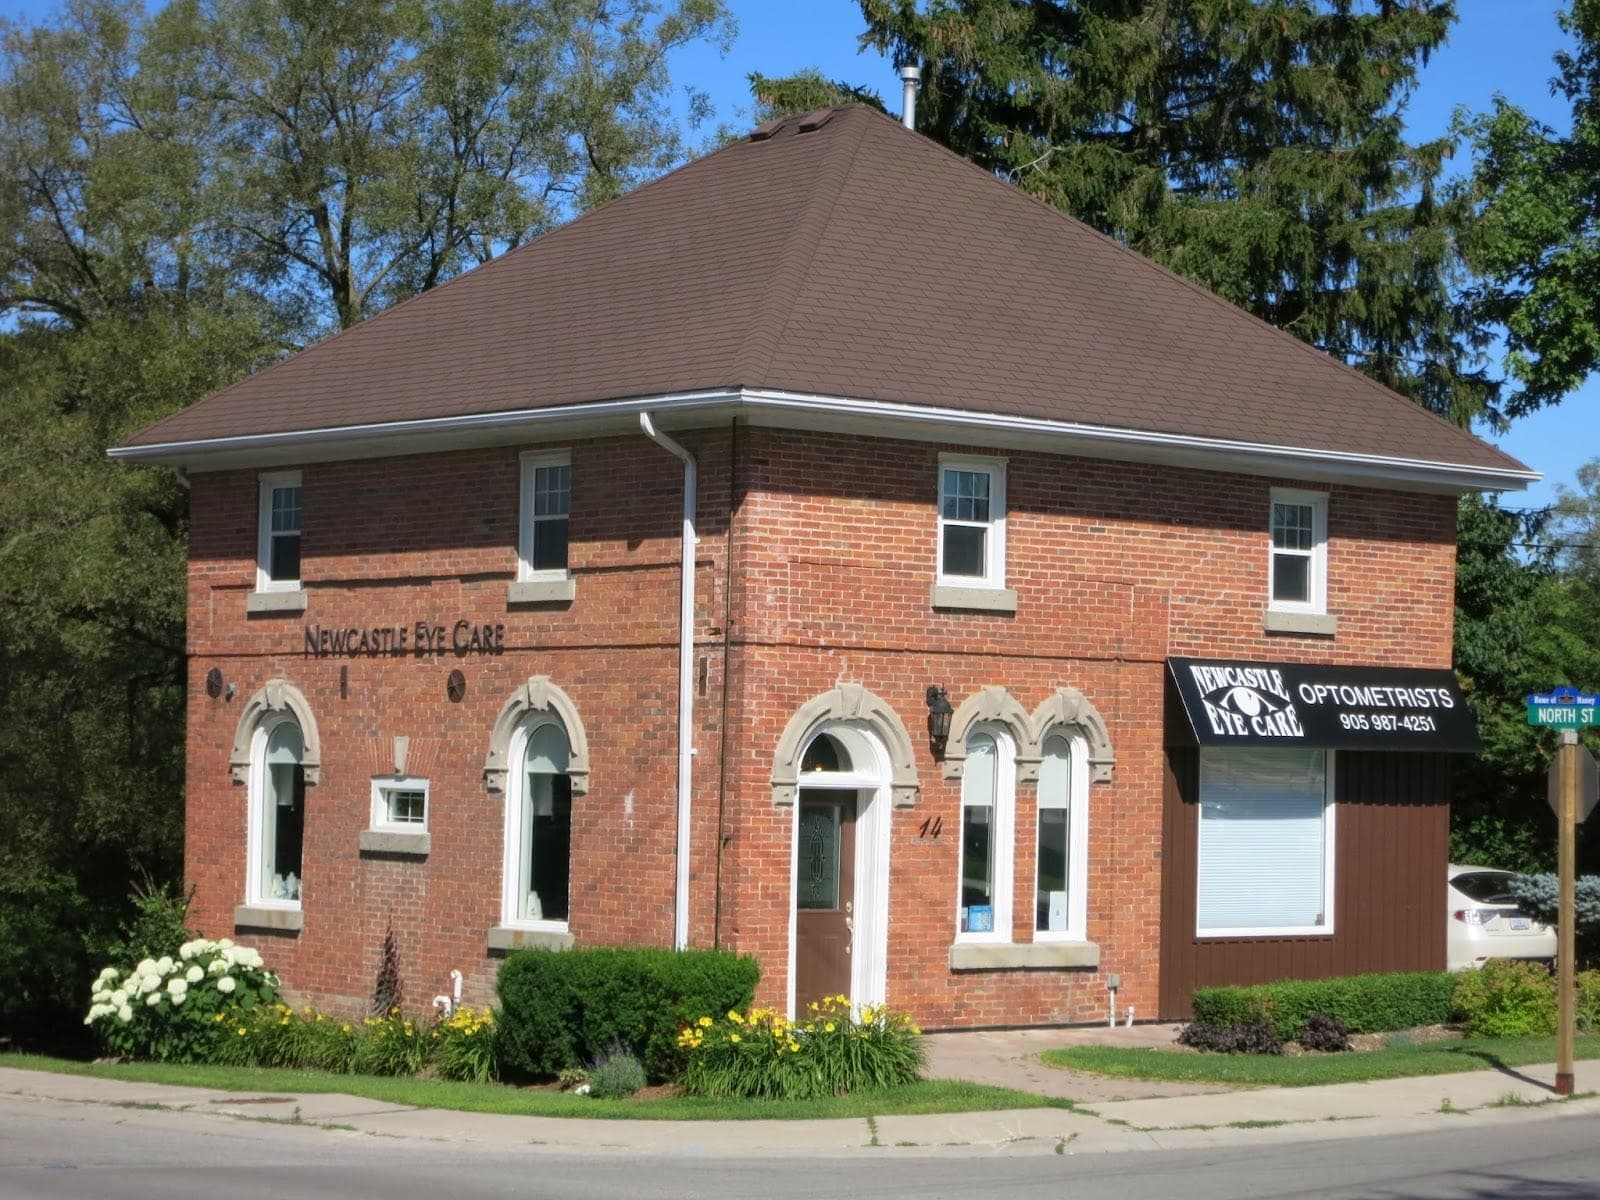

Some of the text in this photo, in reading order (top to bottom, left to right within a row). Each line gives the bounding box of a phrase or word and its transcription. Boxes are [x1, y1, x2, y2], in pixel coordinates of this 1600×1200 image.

[304, 619, 504, 659] NEWCASTLE EYE CARE
[1189, 665, 1290, 701] NEWCASTLE
[1298, 684, 1454, 709] OPTOMETRISTS
[1204, 701, 1305, 737] EYE CARE
[1340, 713, 1436, 732] 905 987-4251
[1538, 708, 1595, 723] NORTH ST
[919, 816, 943, 839] 14
